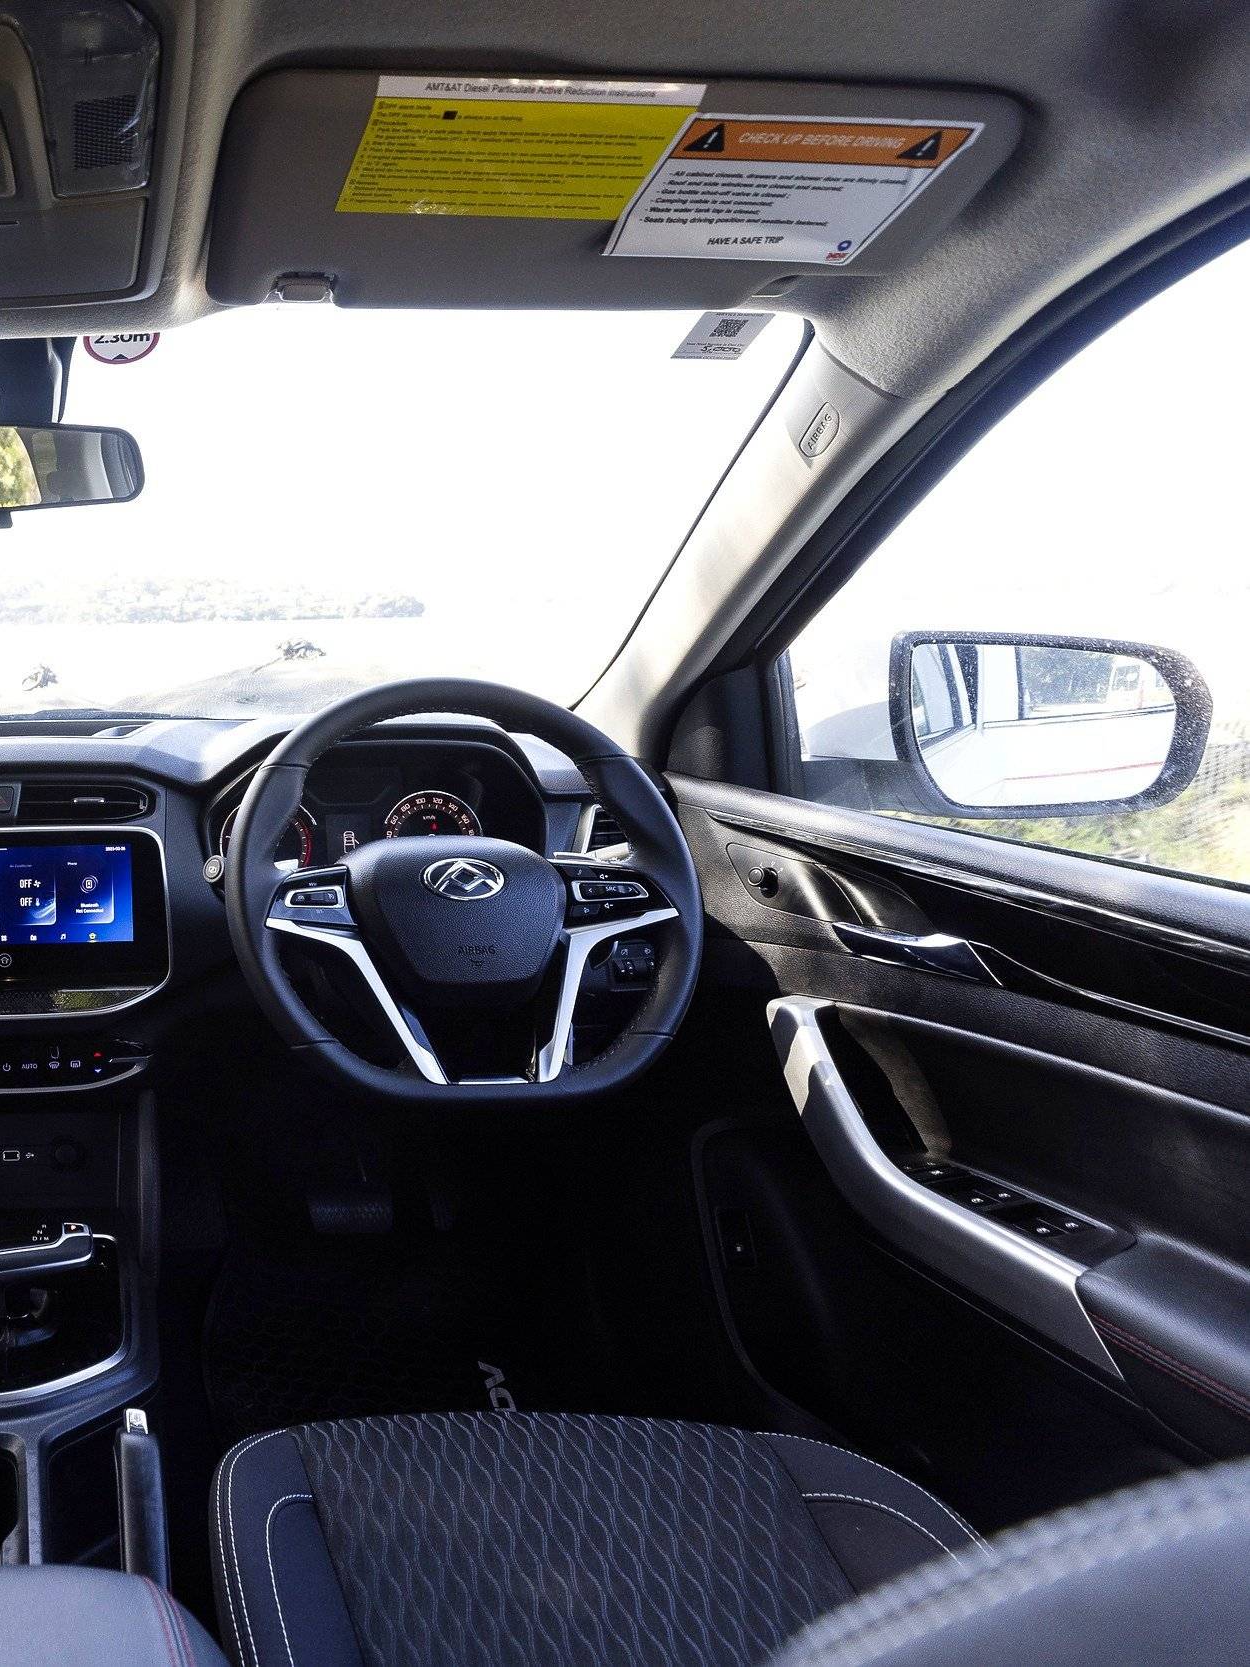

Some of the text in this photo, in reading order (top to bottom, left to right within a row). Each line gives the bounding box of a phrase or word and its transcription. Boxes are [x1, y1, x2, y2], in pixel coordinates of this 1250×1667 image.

[425, 83, 463, 92] AMT&AT
[464, 84, 490, 92] Diesel
[491, 84, 536, 94] Particulate
[537, 86, 564, 94] Active
[565, 86, 607, 96] Reduction
[739, 132, 907, 149] CHECK UP BEFORE DRIVING
[666, 217, 688, 225] facing
[739, 236, 763, 244] SAFE
[764, 236, 784, 244] TRIP
[94, 332, 150, 344] 2.30m
[807, 413, 832, 450] AIRBAG
[390, 814, 398, 825] 60
[19, 879, 32, 888] OFF
[19, 897, 32, 906] OFF
[457, 945, 496, 954] AIRBAG
